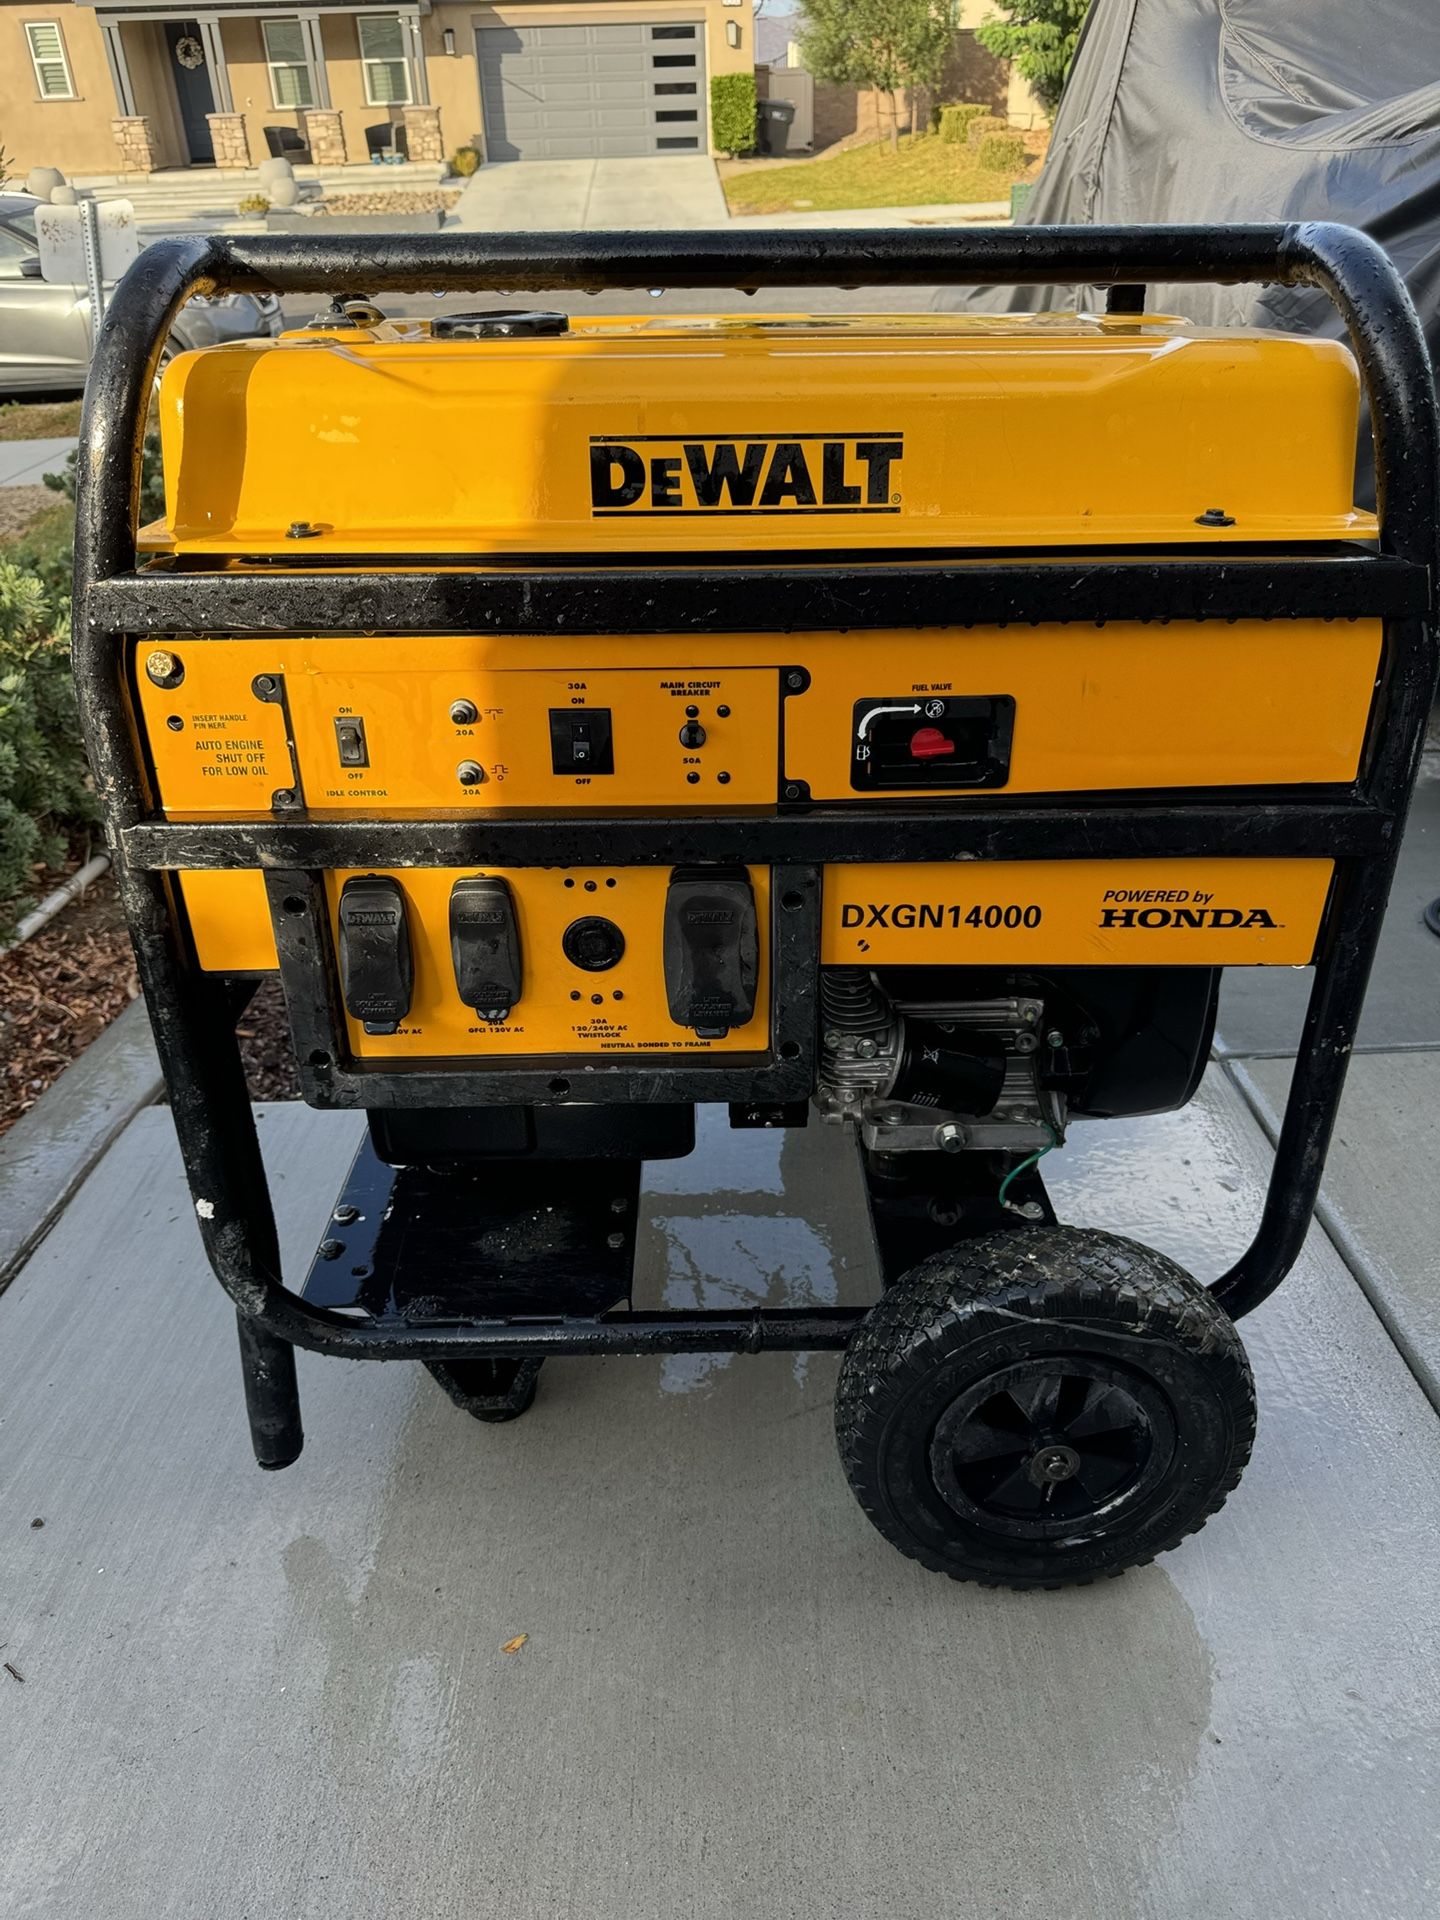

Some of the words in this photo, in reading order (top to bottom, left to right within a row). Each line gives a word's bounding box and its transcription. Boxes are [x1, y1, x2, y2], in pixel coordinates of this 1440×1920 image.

[660, 682, 685, 690] MAIN
[688, 681, 721, 689] CIRCUIT
[912, 684, 929, 692] FUEL
[931, 683, 952, 691] VALVE
[670, 689, 711, 697] BREAKER
[195, 741, 222, 750] AUTO
[225, 740, 264, 750] ENGINE
[216, 753, 243, 763] SHUT
[246, 753, 266, 763] OFF
[202, 767, 223, 776] FOR
[226, 766, 248, 776] LOW
[252, 766, 269, 775] OIL
[1103, 890, 1189, 903] POWERED
[1192, 890, 1214, 905] by
[841, 904, 1042, 929] DXGN14000
